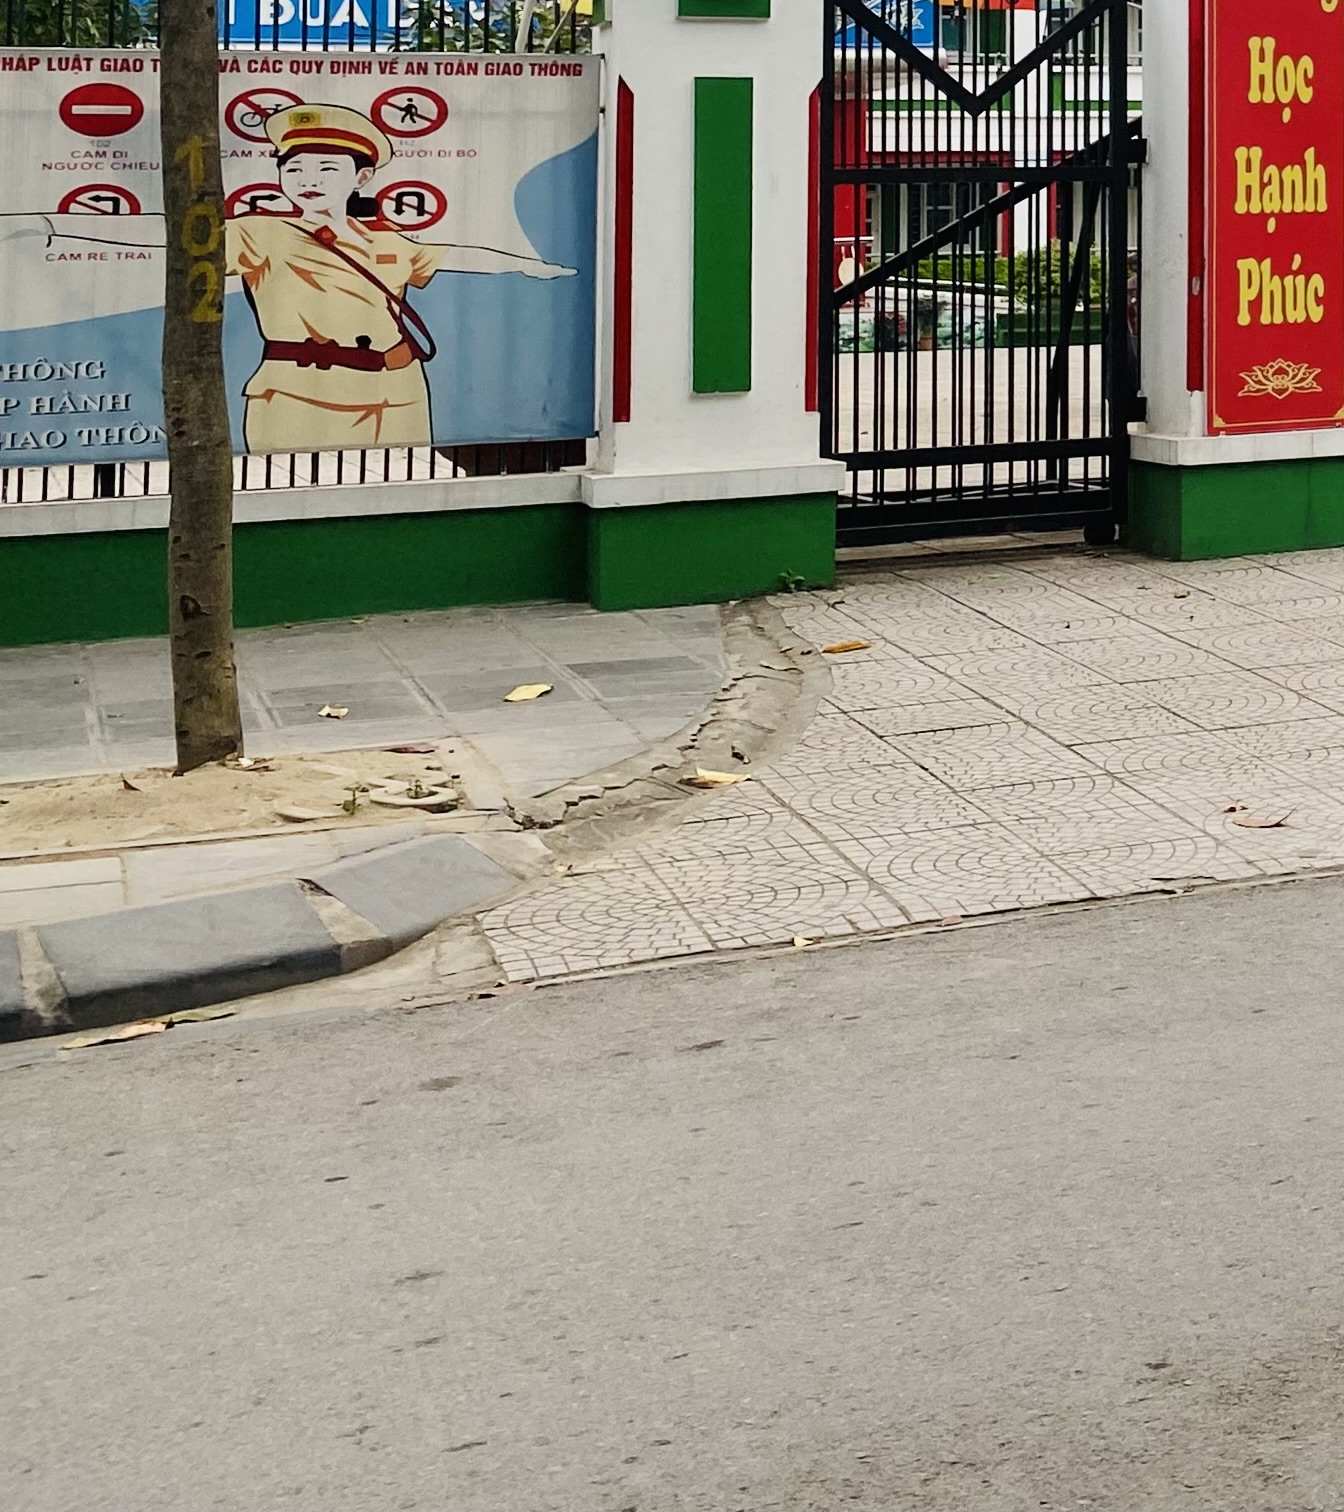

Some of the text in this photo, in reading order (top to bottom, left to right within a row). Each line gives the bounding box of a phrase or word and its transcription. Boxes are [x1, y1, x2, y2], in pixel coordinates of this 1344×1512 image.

[0, 54, 40, 71] HÁP
[47, 54, 94, 75] LUẬT
[100, 57, 144, 72] GIAO
[217, 55, 241, 73] VÀ
[247, 55, 283, 73] CÁC
[289, 59, 324, 75] QUY
[330, 59, 372, 78] ĐỊNH
[404, 61, 428, 76] AN
[434, 58, 479, 76] TOÀN
[484, 62, 523, 77] GIAO
[529, 60, 583, 77] THÔNG
[1248, 36, 1314, 123] Học
[1234, 146, 1328, 233] Hạnh
[1236, 253, 1325, 326] Phúc
[29, 391, 131, 416] HÀNH
[0, 420, 167, 452] IAO THÔN
